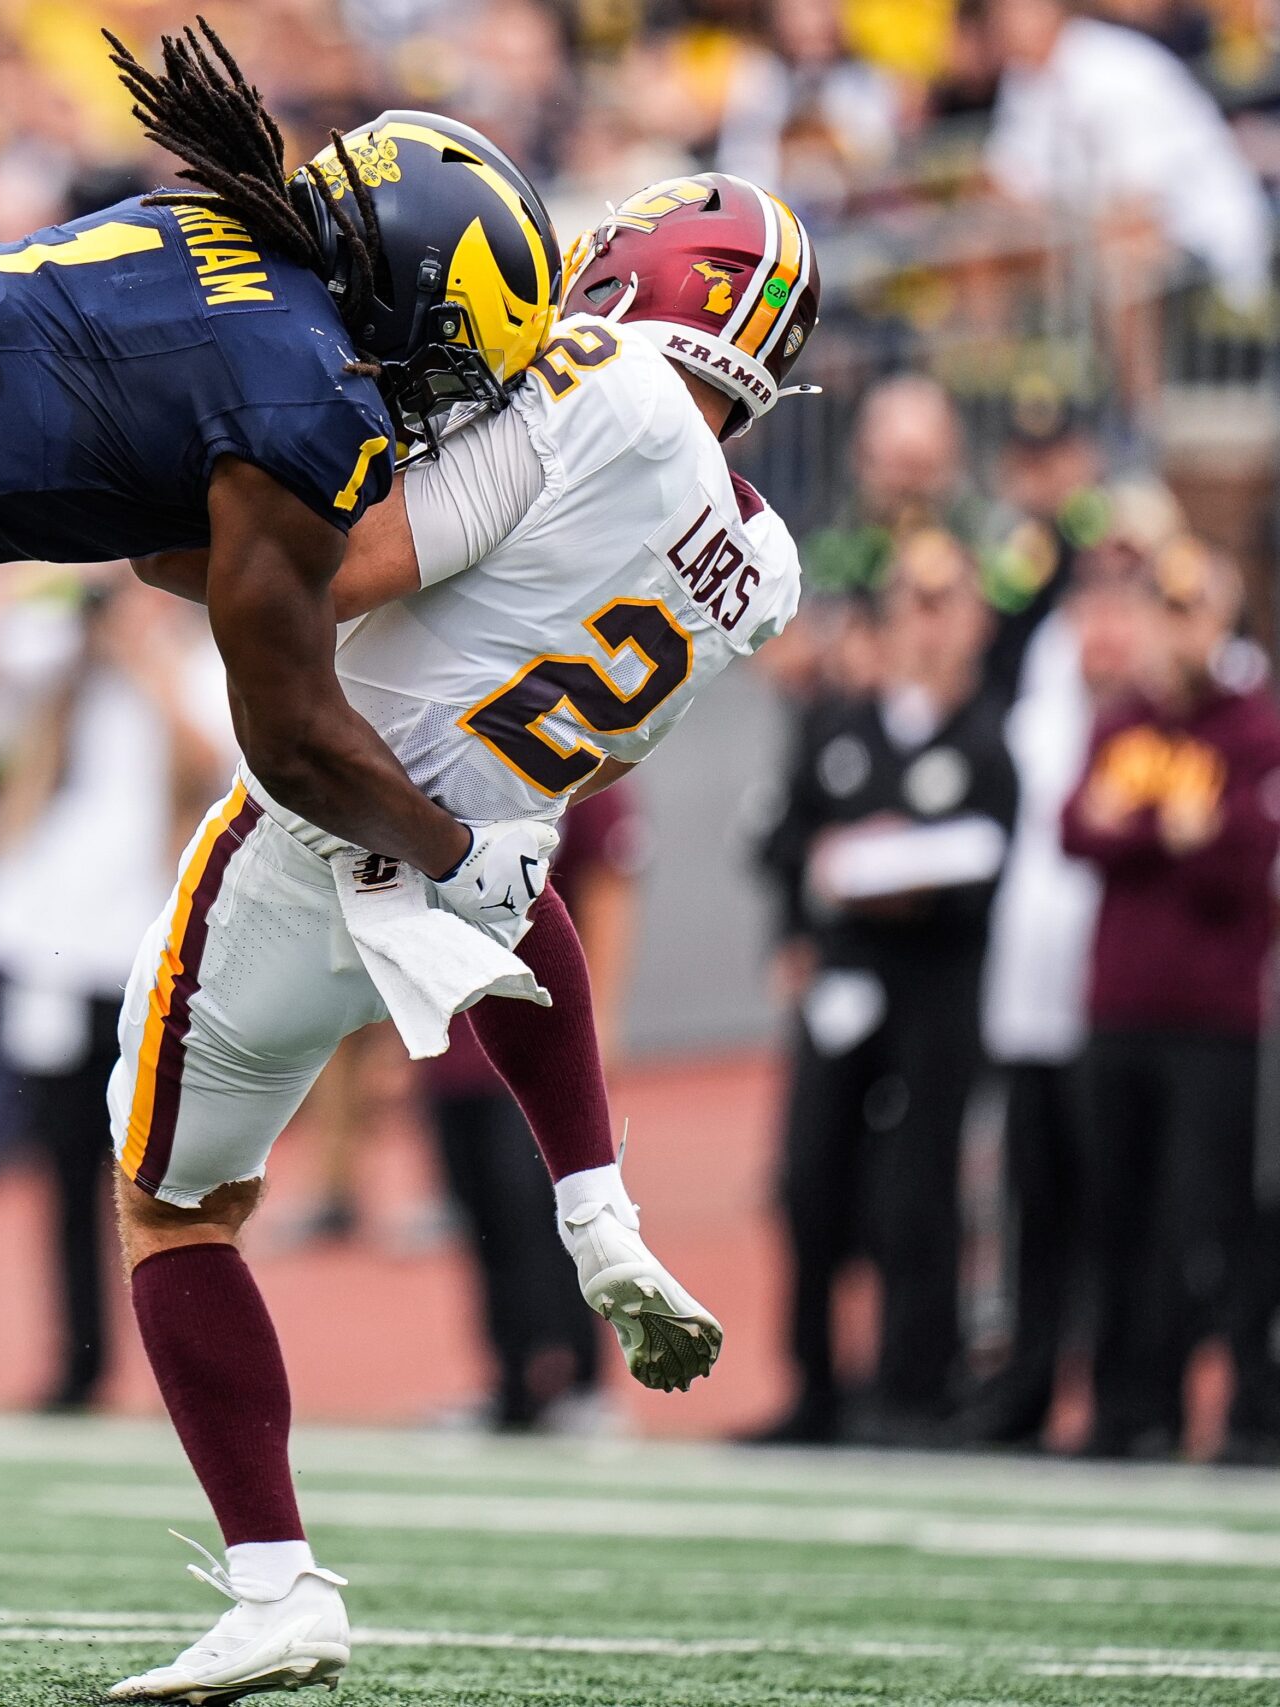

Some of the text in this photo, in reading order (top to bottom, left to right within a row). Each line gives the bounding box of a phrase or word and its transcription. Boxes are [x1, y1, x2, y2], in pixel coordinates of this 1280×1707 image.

[156, 193, 274, 306] RHAM
[766, 283, 787, 300] C2P
[527, 323, 622, 404] 2
[666, 334, 772, 405] KRAMER
[333, 435, 389, 512] 1
[456, 597, 693, 799] 2
